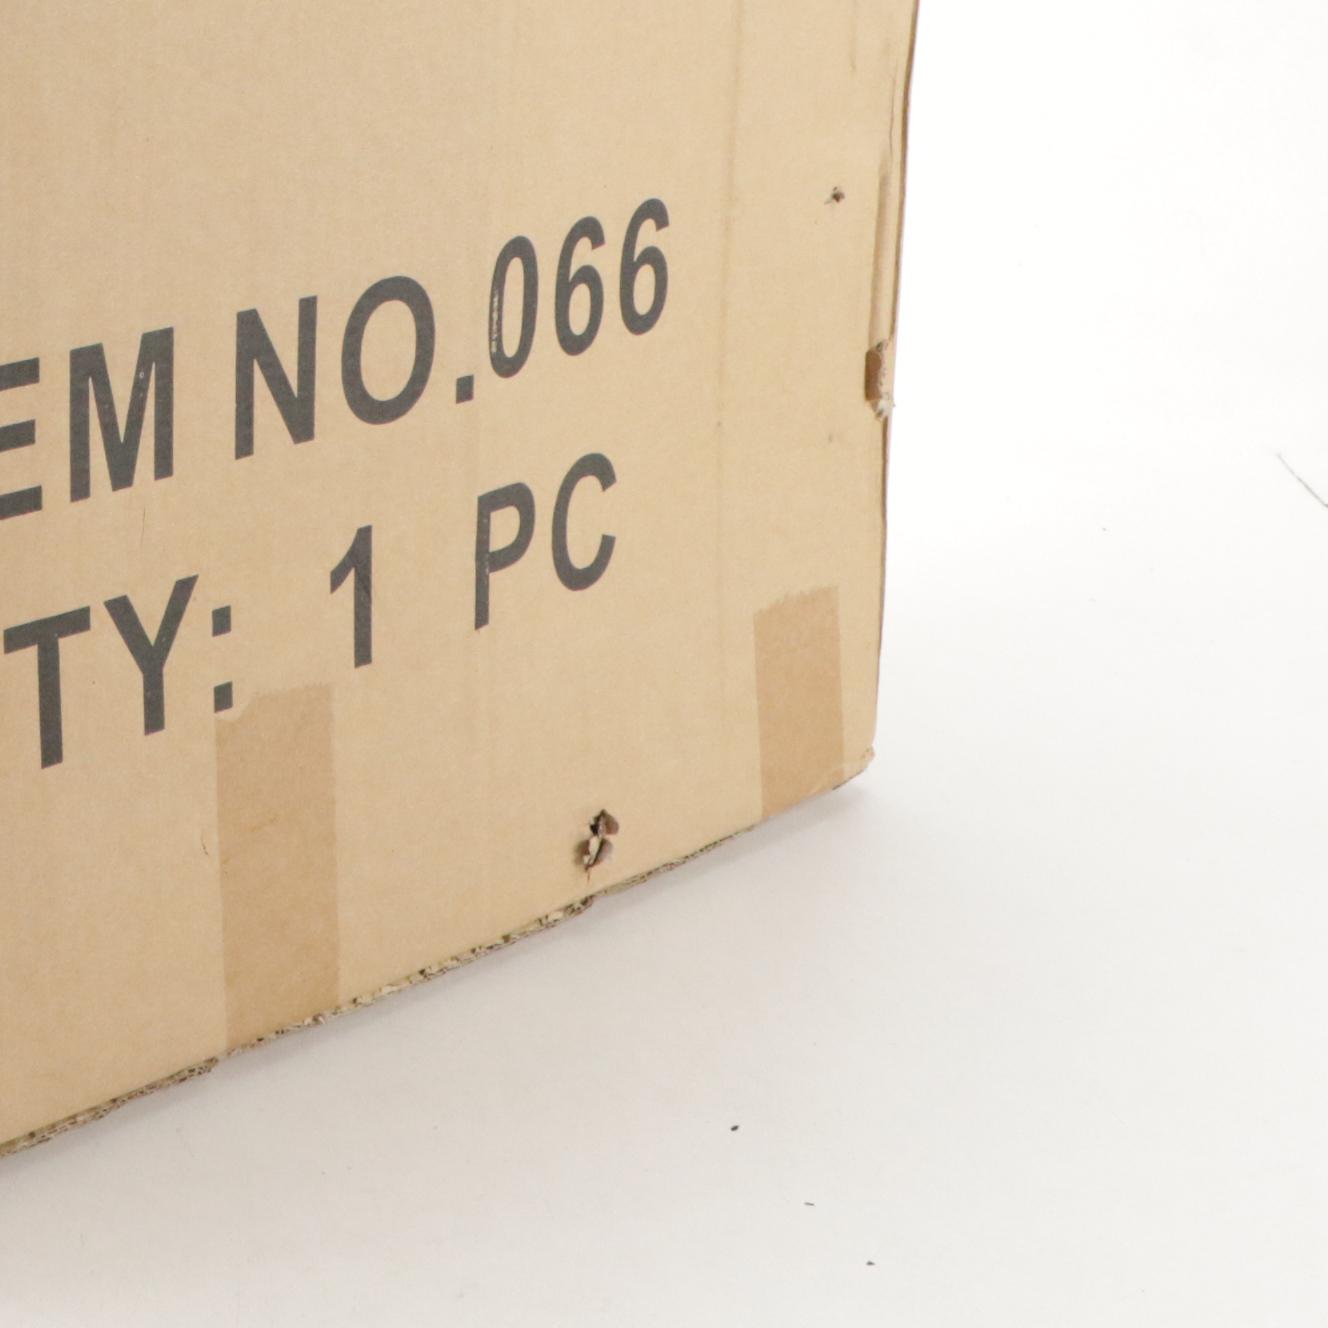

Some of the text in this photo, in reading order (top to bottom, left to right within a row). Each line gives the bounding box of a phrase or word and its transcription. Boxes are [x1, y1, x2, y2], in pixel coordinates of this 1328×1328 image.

[234, 197, 670, 461] NO.066
[328, 524, 373, 670] 1
[473, 452, 618, 632] PC
